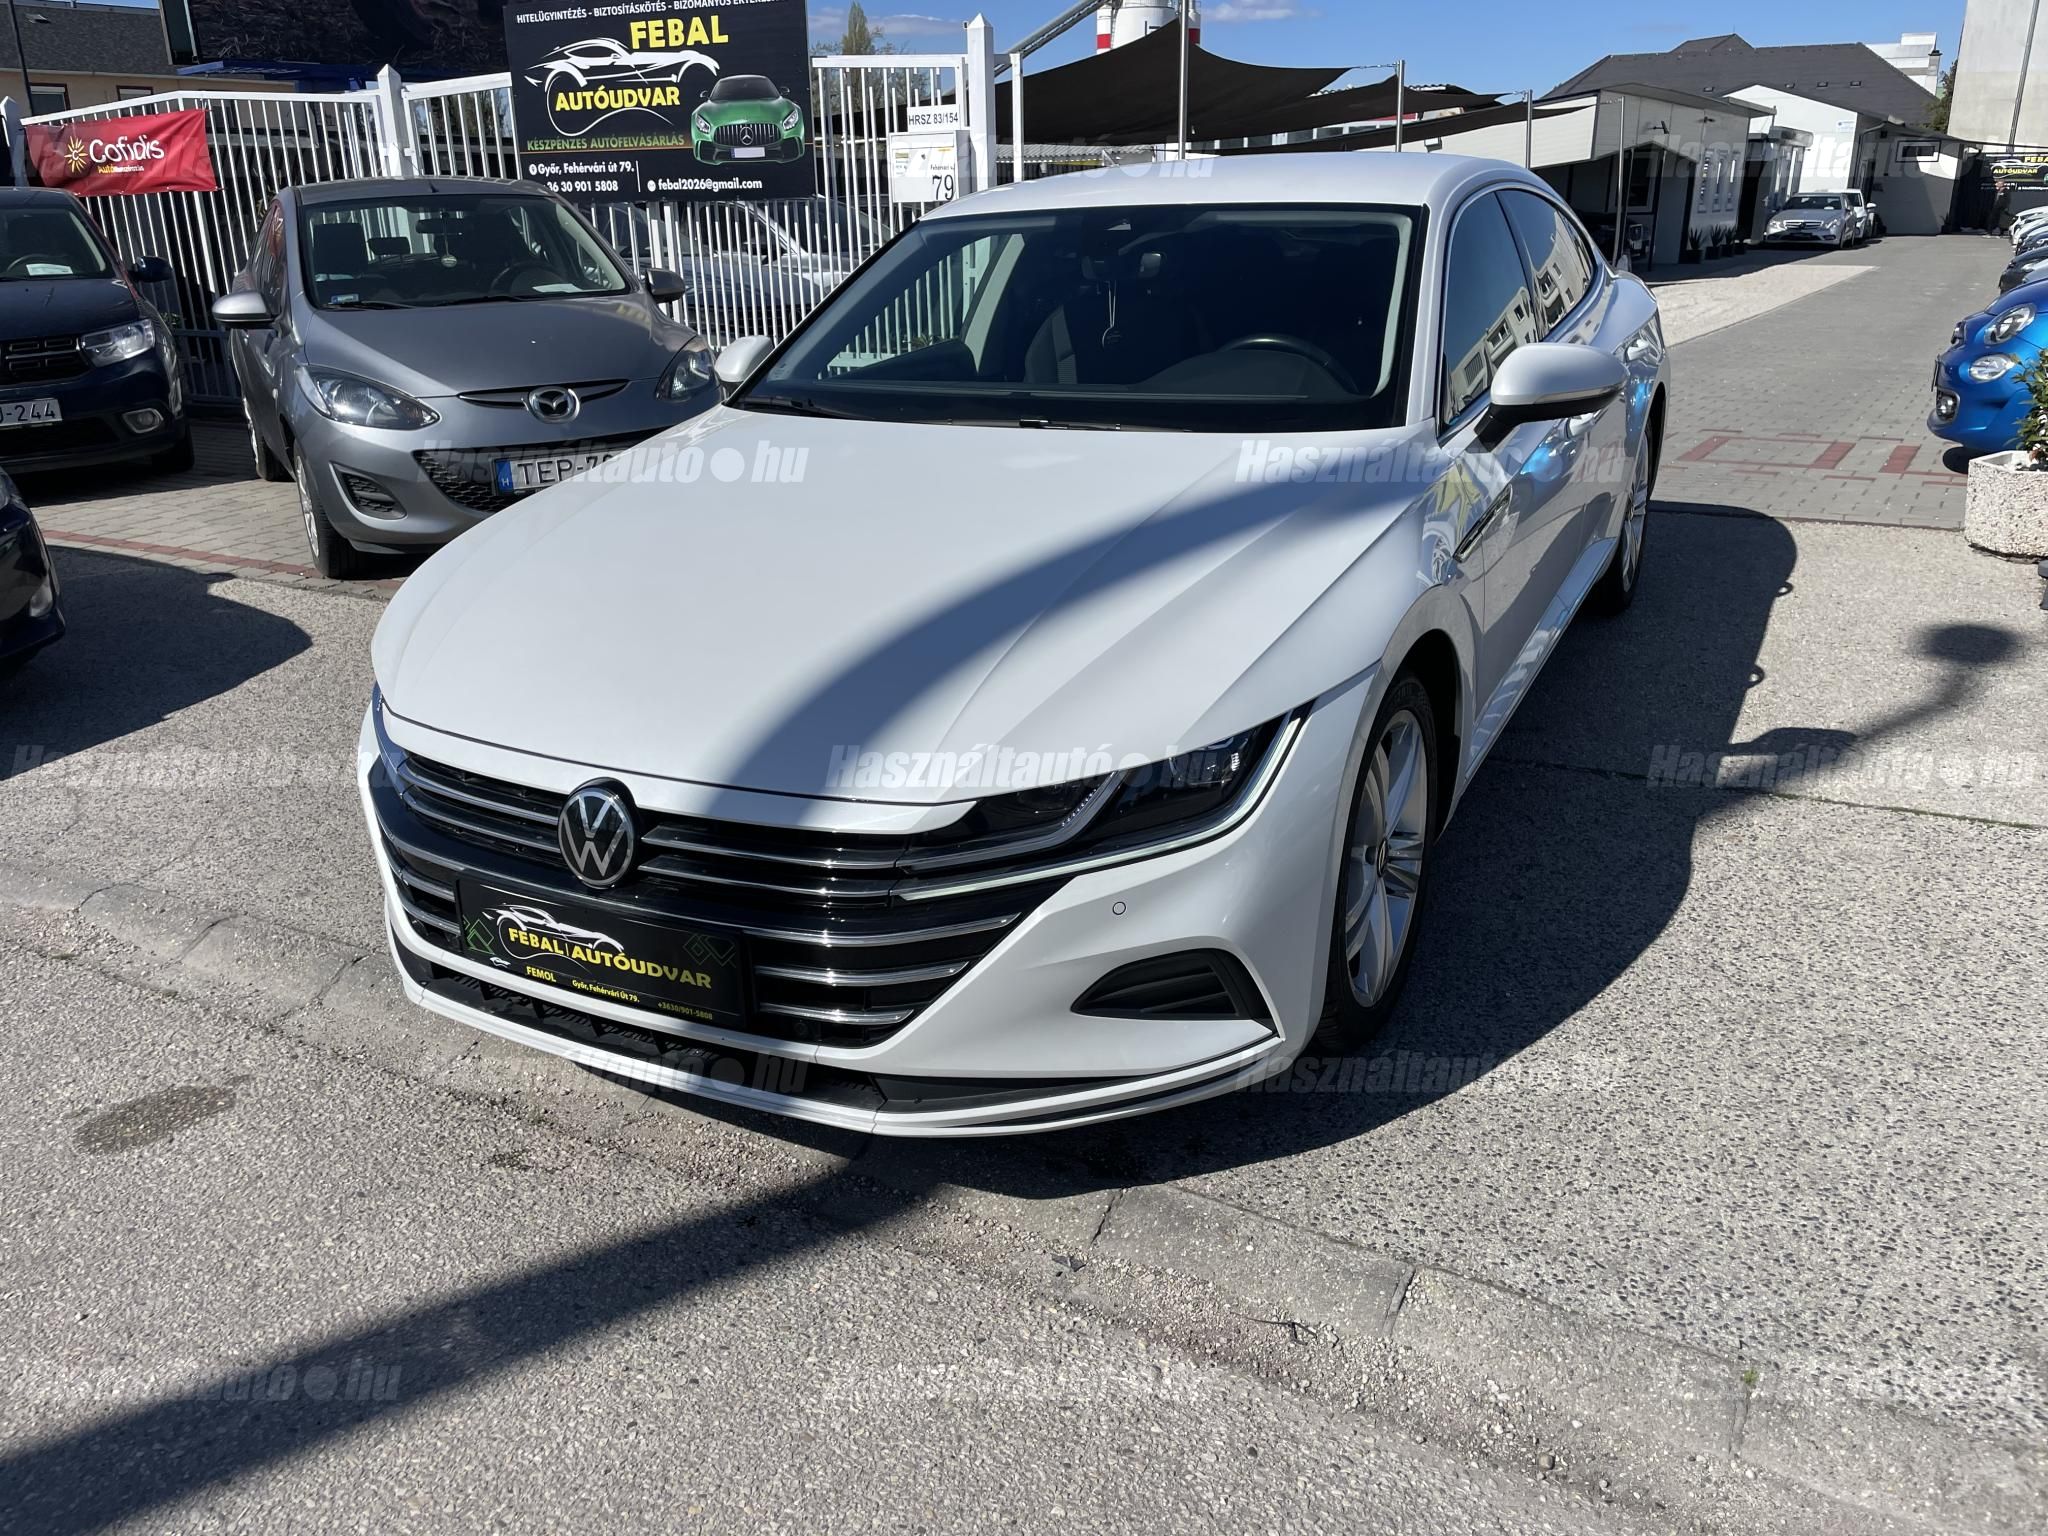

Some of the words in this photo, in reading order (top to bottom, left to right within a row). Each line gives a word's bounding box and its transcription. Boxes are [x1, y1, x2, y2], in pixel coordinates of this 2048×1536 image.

[516, 8, 587, 24] HITELÜGYINTÉZÉS
[593, 0, 666, 17] BIZTOSÍTÁSKÖTÉS
[630, 15, 728, 49] FEBAL
[555, 85, 680, 111] AUTÓUDVAR
[908, 114, 931, 125] HRSZ
[933, 112, 958, 124] 83/154
[89, 135, 165, 163] Cofidis
[527, 137, 588, 151] KÉSZPÉNZES
[590, 132, 685, 149] AUTÓFELVÁSÁRLÁS
[538, 163, 562, 177] Győr,
[563, 161, 606, 174] Fehérvári
[608, 161, 617, 172] út
[619, 161, 635, 172] 79.
[544, 181, 559, 192] 36
[560, 181, 573, 192] 30
[574, 181, 591, 192] 901
[594, 180, 618, 192] 5808
[658, 177, 762, 192] febal2026@gmail.com
[932, 174, 954, 201] 79
[508, 927, 564, 955] FEBAL
[571, 944, 712, 989] AUTÓUDVAR
[526, 965, 557, 983] FEMOL
